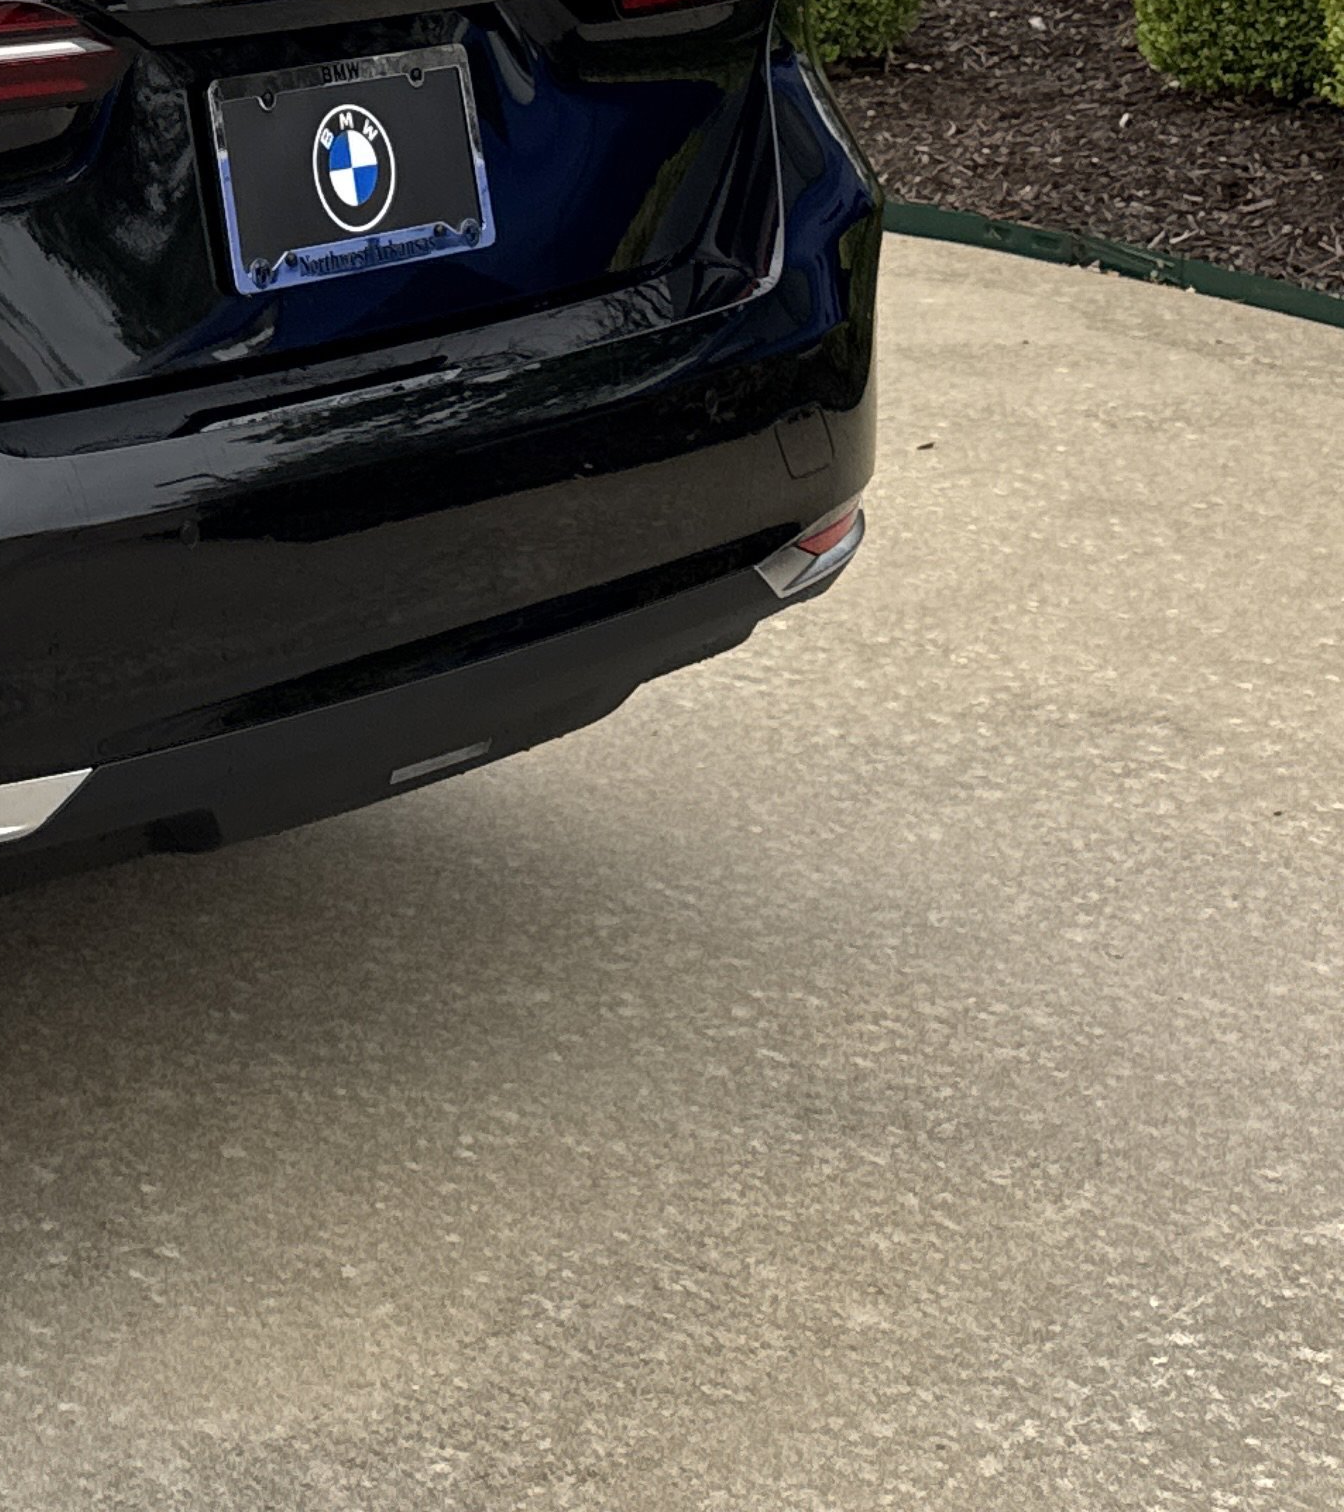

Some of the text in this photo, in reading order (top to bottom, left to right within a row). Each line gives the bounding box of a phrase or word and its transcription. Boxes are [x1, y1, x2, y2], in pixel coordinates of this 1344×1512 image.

[321, 62, 360, 83] BMW
[319, 111, 379, 150] BMW
[299, 247, 369, 277] Northwest
